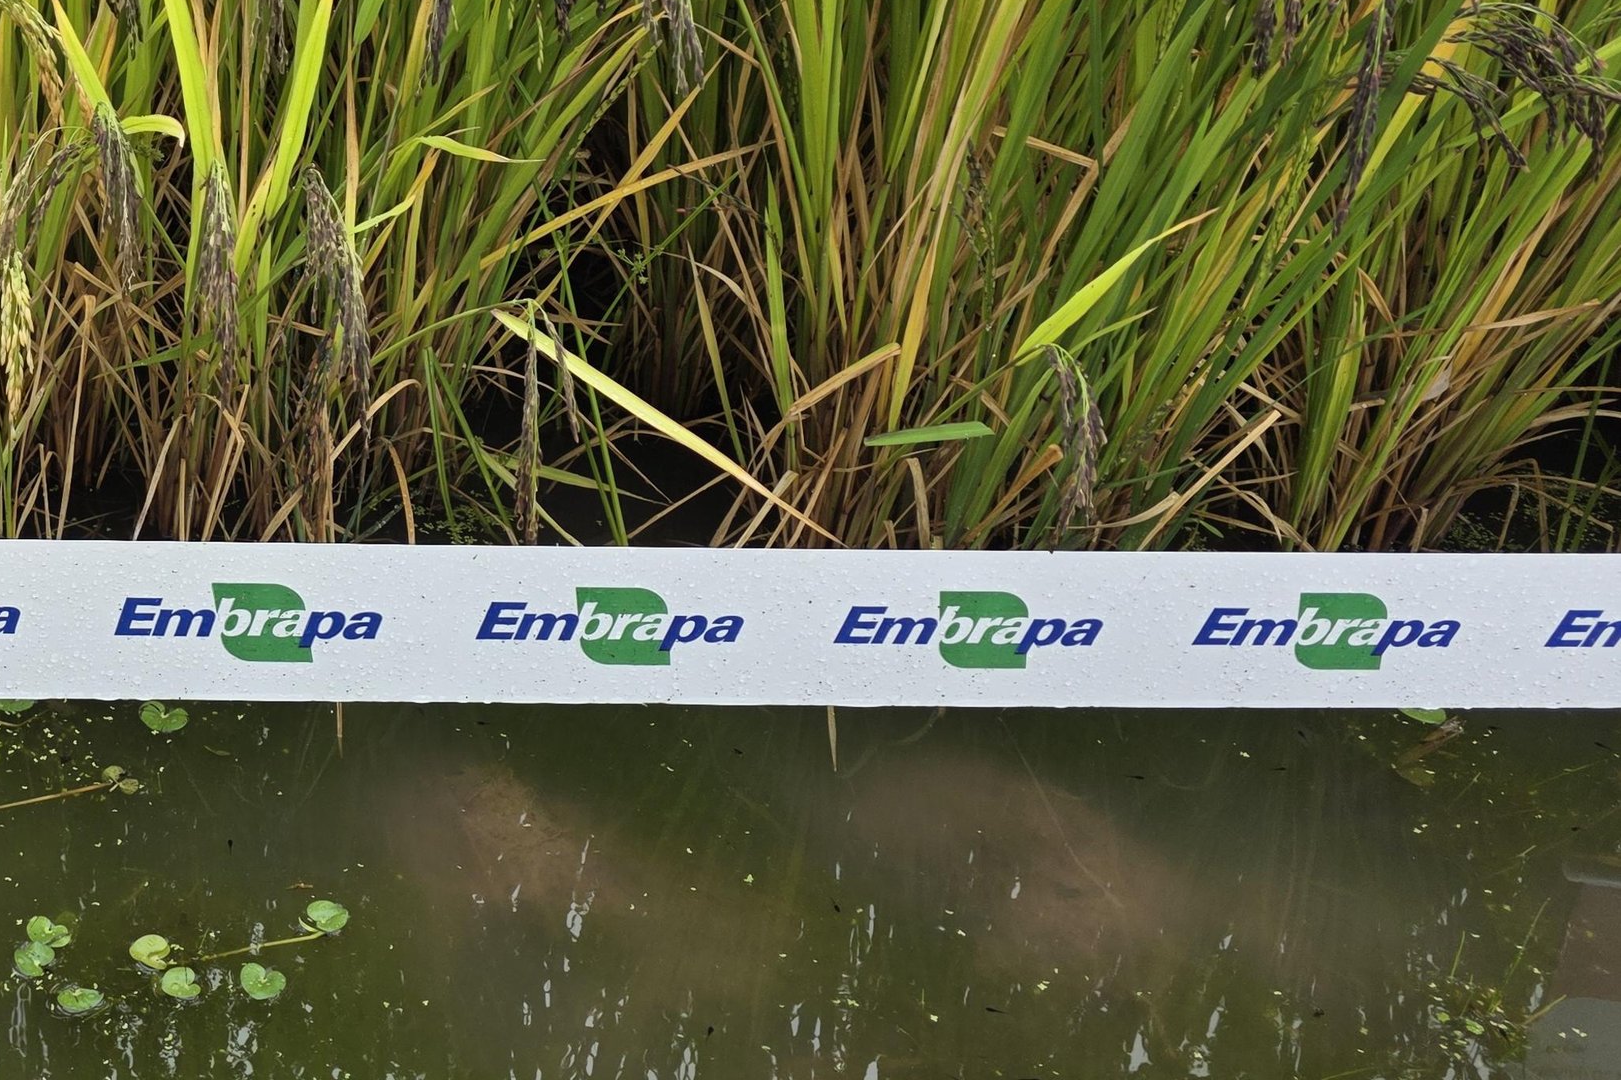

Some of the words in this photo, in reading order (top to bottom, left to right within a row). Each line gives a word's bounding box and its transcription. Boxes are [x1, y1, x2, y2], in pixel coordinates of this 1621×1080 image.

[114, 597, 382, 648] Embrapa
[475, 601, 744, 650] Embrapa
[833, 606, 1103, 654] Embrapa
[1192, 607, 1461, 655] Embrapa
